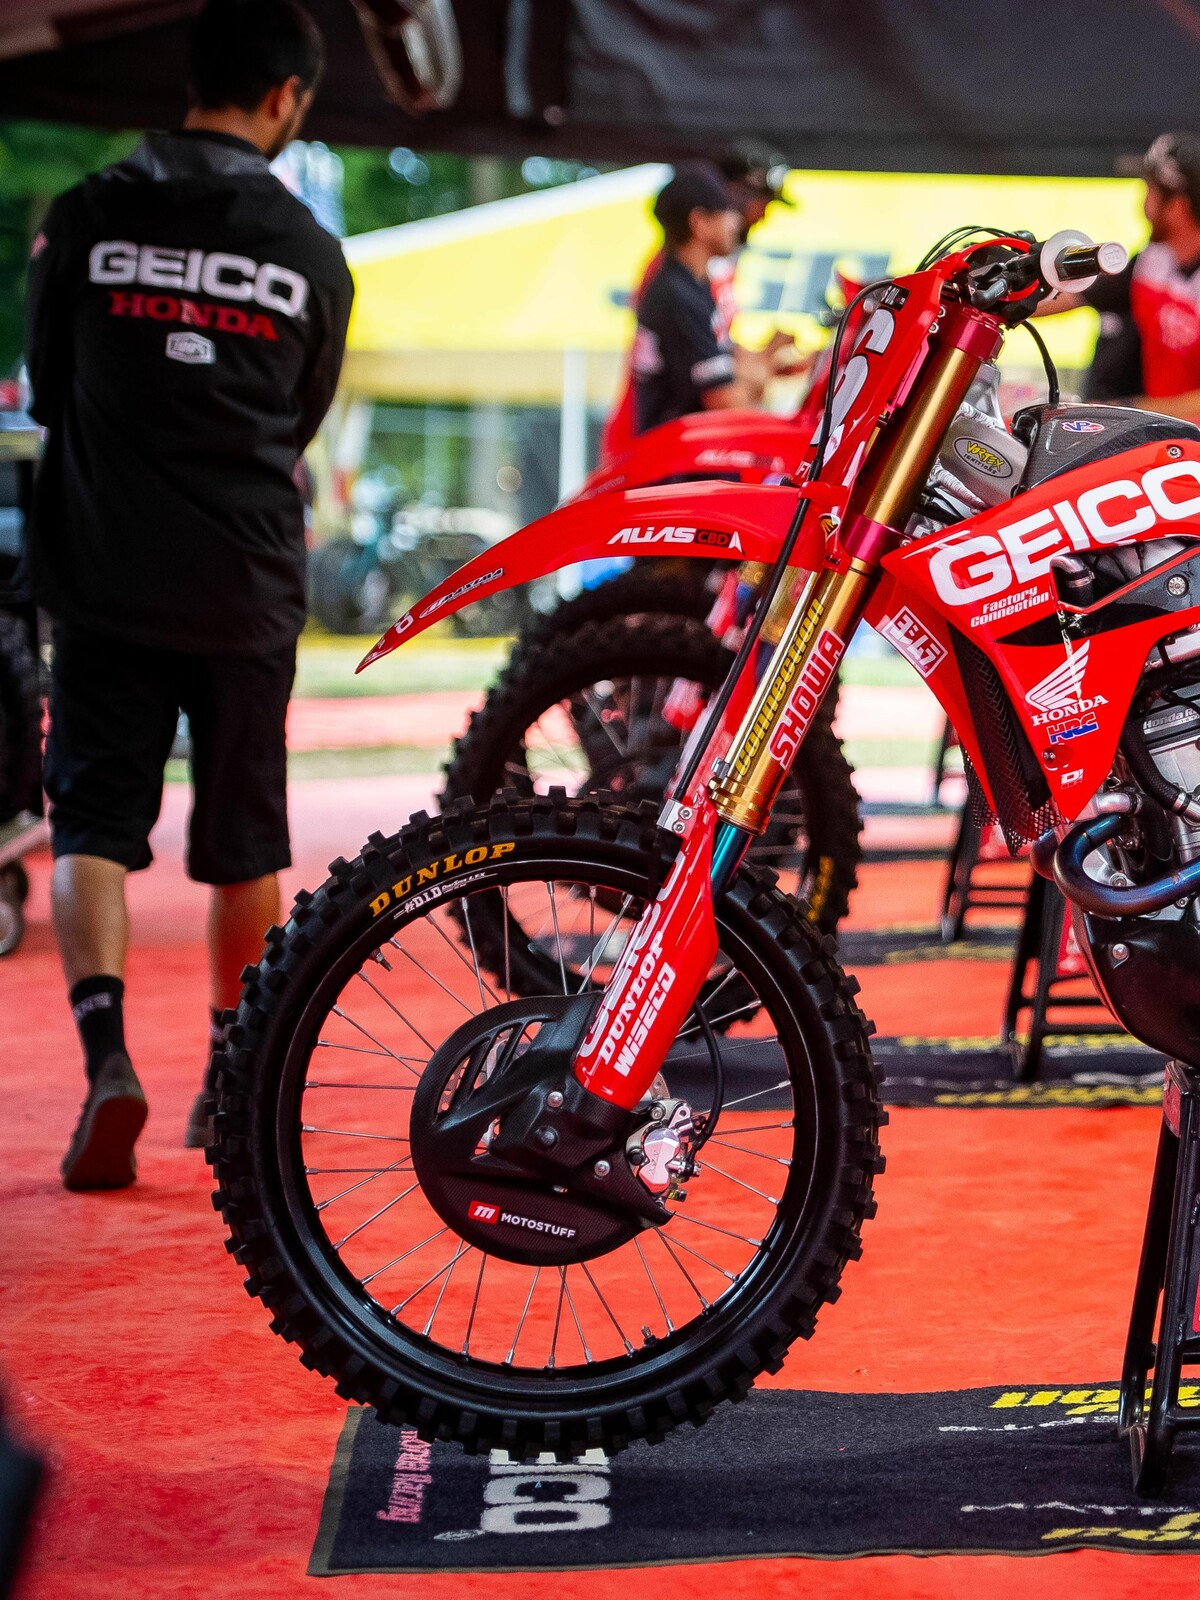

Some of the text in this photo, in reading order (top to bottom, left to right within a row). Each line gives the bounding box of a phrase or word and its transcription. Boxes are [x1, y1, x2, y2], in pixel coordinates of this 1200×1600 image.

[89, 240, 310, 318] GEICO
[110, 291, 279, 341] HONDA
[963, 452, 997, 475] IGNITIONS
[966, 440, 1005, 472] VORTEX
[697, 531, 728, 546] CBD
[767, 626, 846, 771] SHOWA
[1031, 694, 1109, 727] HONDA
[1046, 711, 1099, 745] HRC
[1143, 709, 1185, 730] Honda
[369, 842, 516, 918] DUNLOP
[598, 930, 664, 1066] DUNLOP
[500, 1212, 577, 1239] MOTOSTUFF
